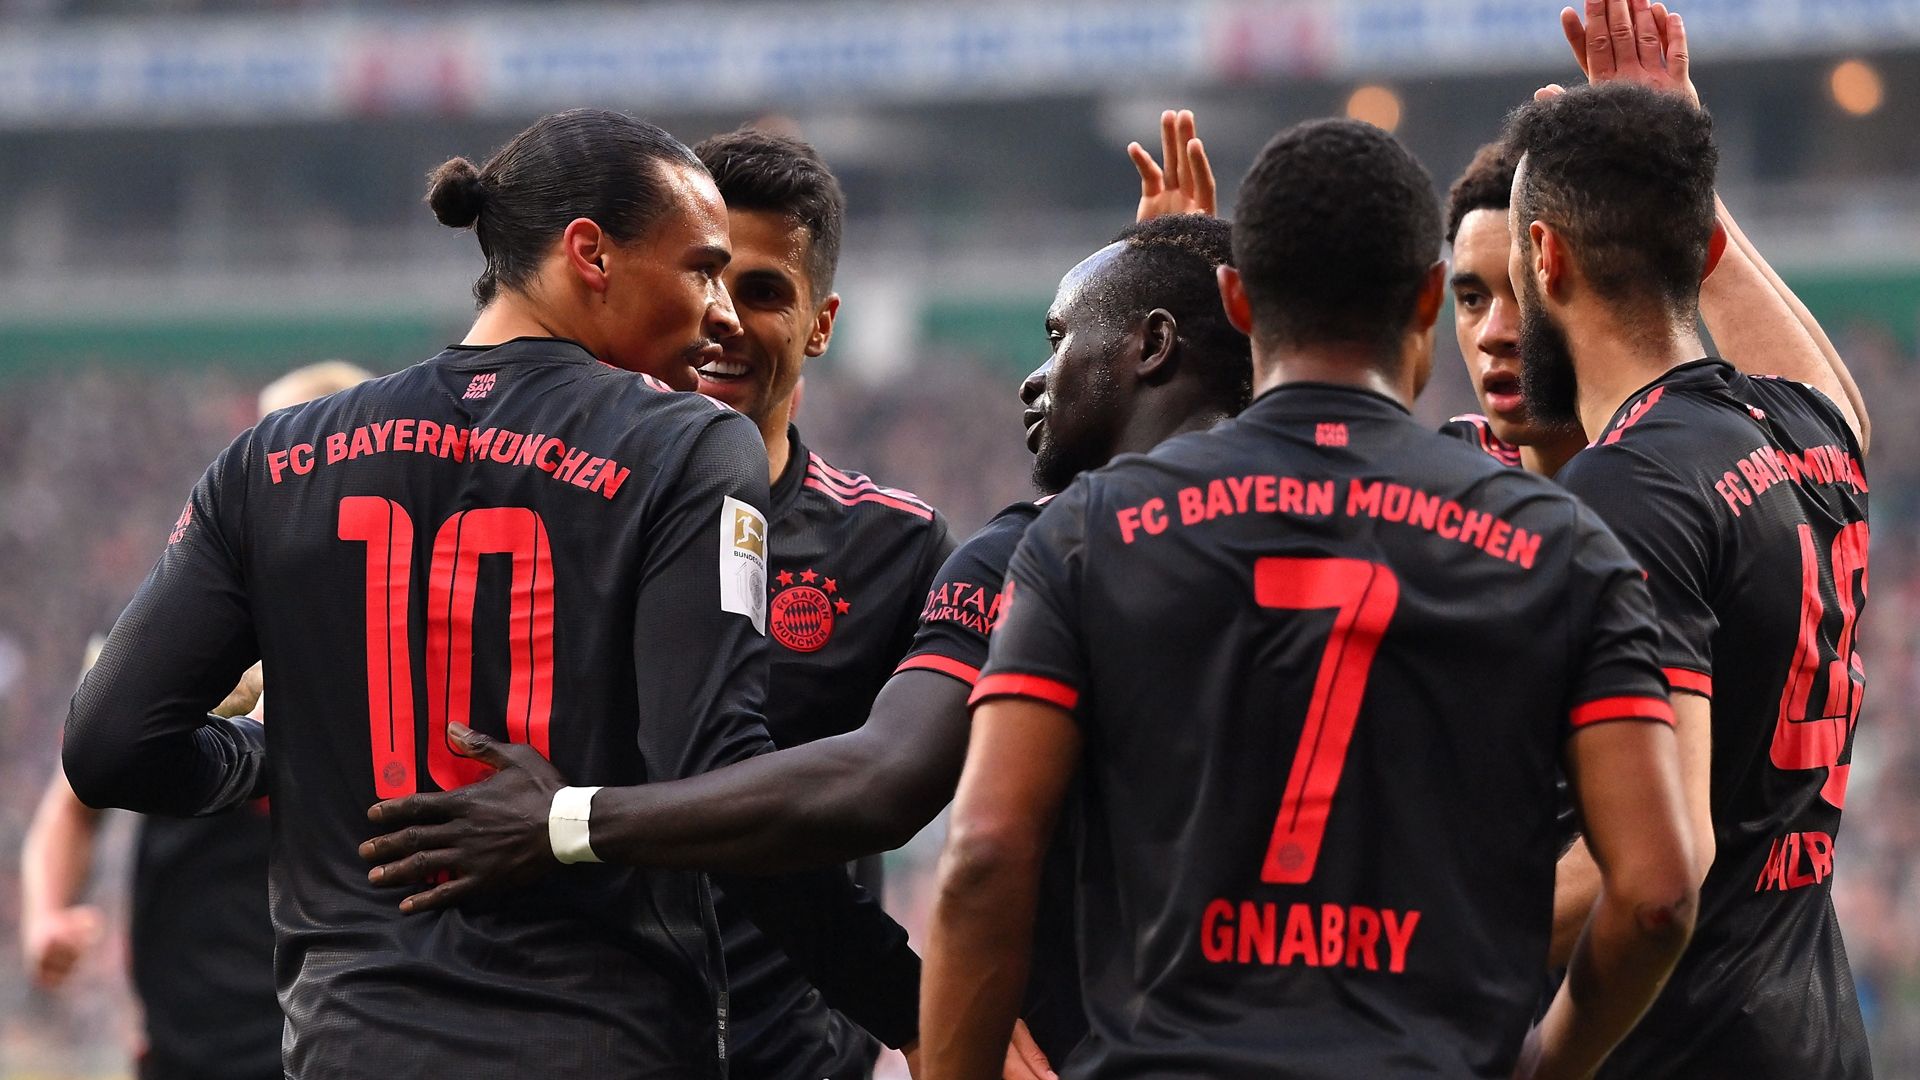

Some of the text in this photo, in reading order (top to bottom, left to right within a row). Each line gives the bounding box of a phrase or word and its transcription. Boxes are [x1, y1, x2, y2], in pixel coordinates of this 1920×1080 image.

[461, 390, 487, 400] MIA
[467, 382, 495, 392] SAN
[471, 373, 497, 383] MIA
[267, 419, 631, 500] FC BAYERN MÜNCHEN
[1715, 471, 1752, 518] FC
[1736, 445, 1801, 496] BAY
[1116, 476, 1542, 570] FC BAYERN MÜNCHEN
[733, 550, 764, 571] BUNDES
[775, 591, 831, 620] FC BAYERN
[924, 606, 998, 635] AIRWAY
[338, 496, 555, 800] 10
[1254, 557, 1400, 884] 7
[1201, 898, 1421, 973] GNABRY
